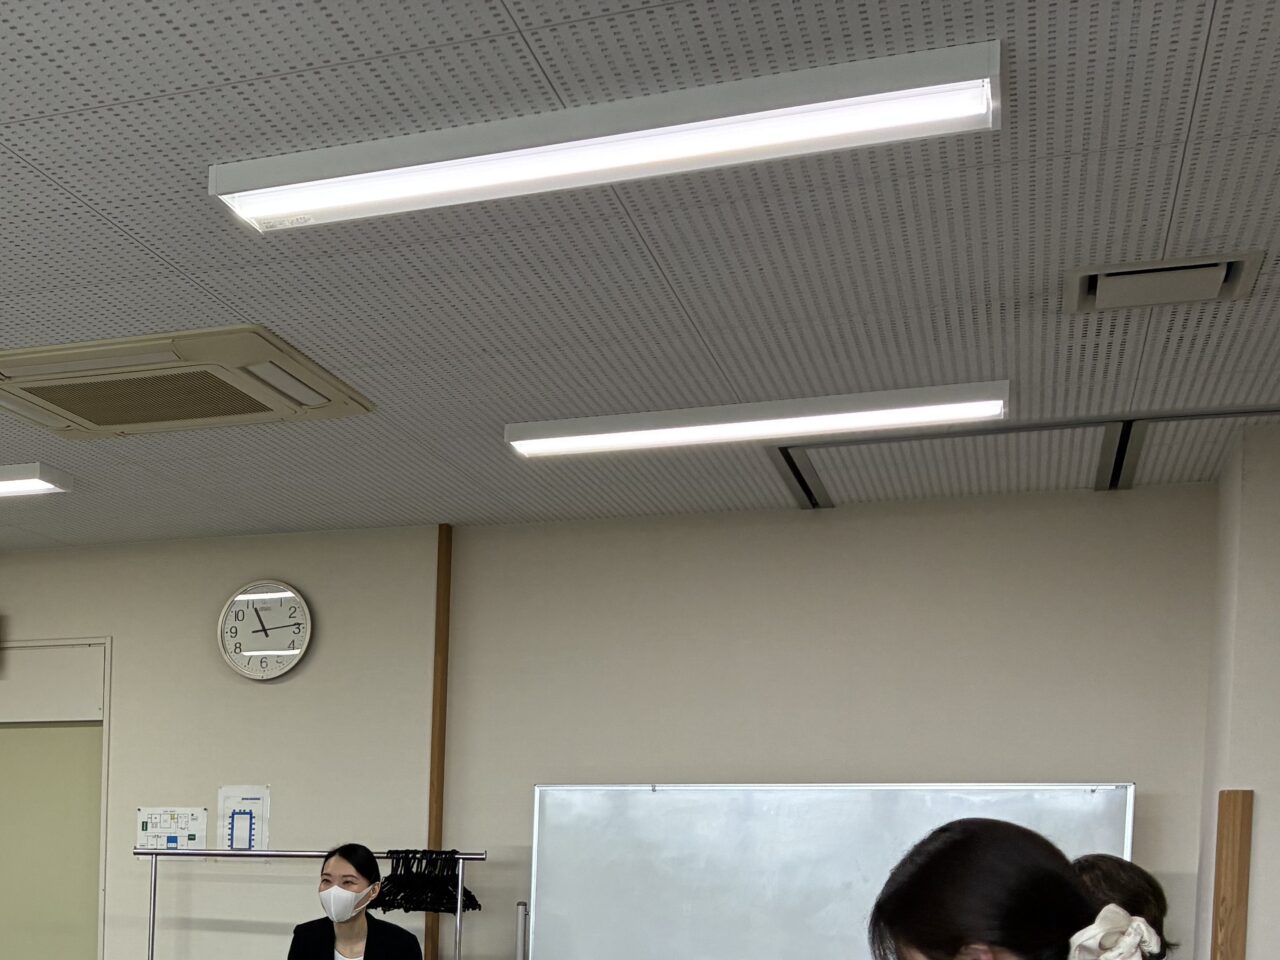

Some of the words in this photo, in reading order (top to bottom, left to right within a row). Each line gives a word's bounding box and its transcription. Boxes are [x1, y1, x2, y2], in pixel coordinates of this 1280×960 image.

[234, 609, 245, 622] 10
[288, 606, 297, 619] 2
[229, 626, 238, 638] 9
[292, 622, 301, 635] 3
[233, 642, 242, 654] 8
[287, 640, 295, 651] 4
[260, 657, 269, 669] 6
